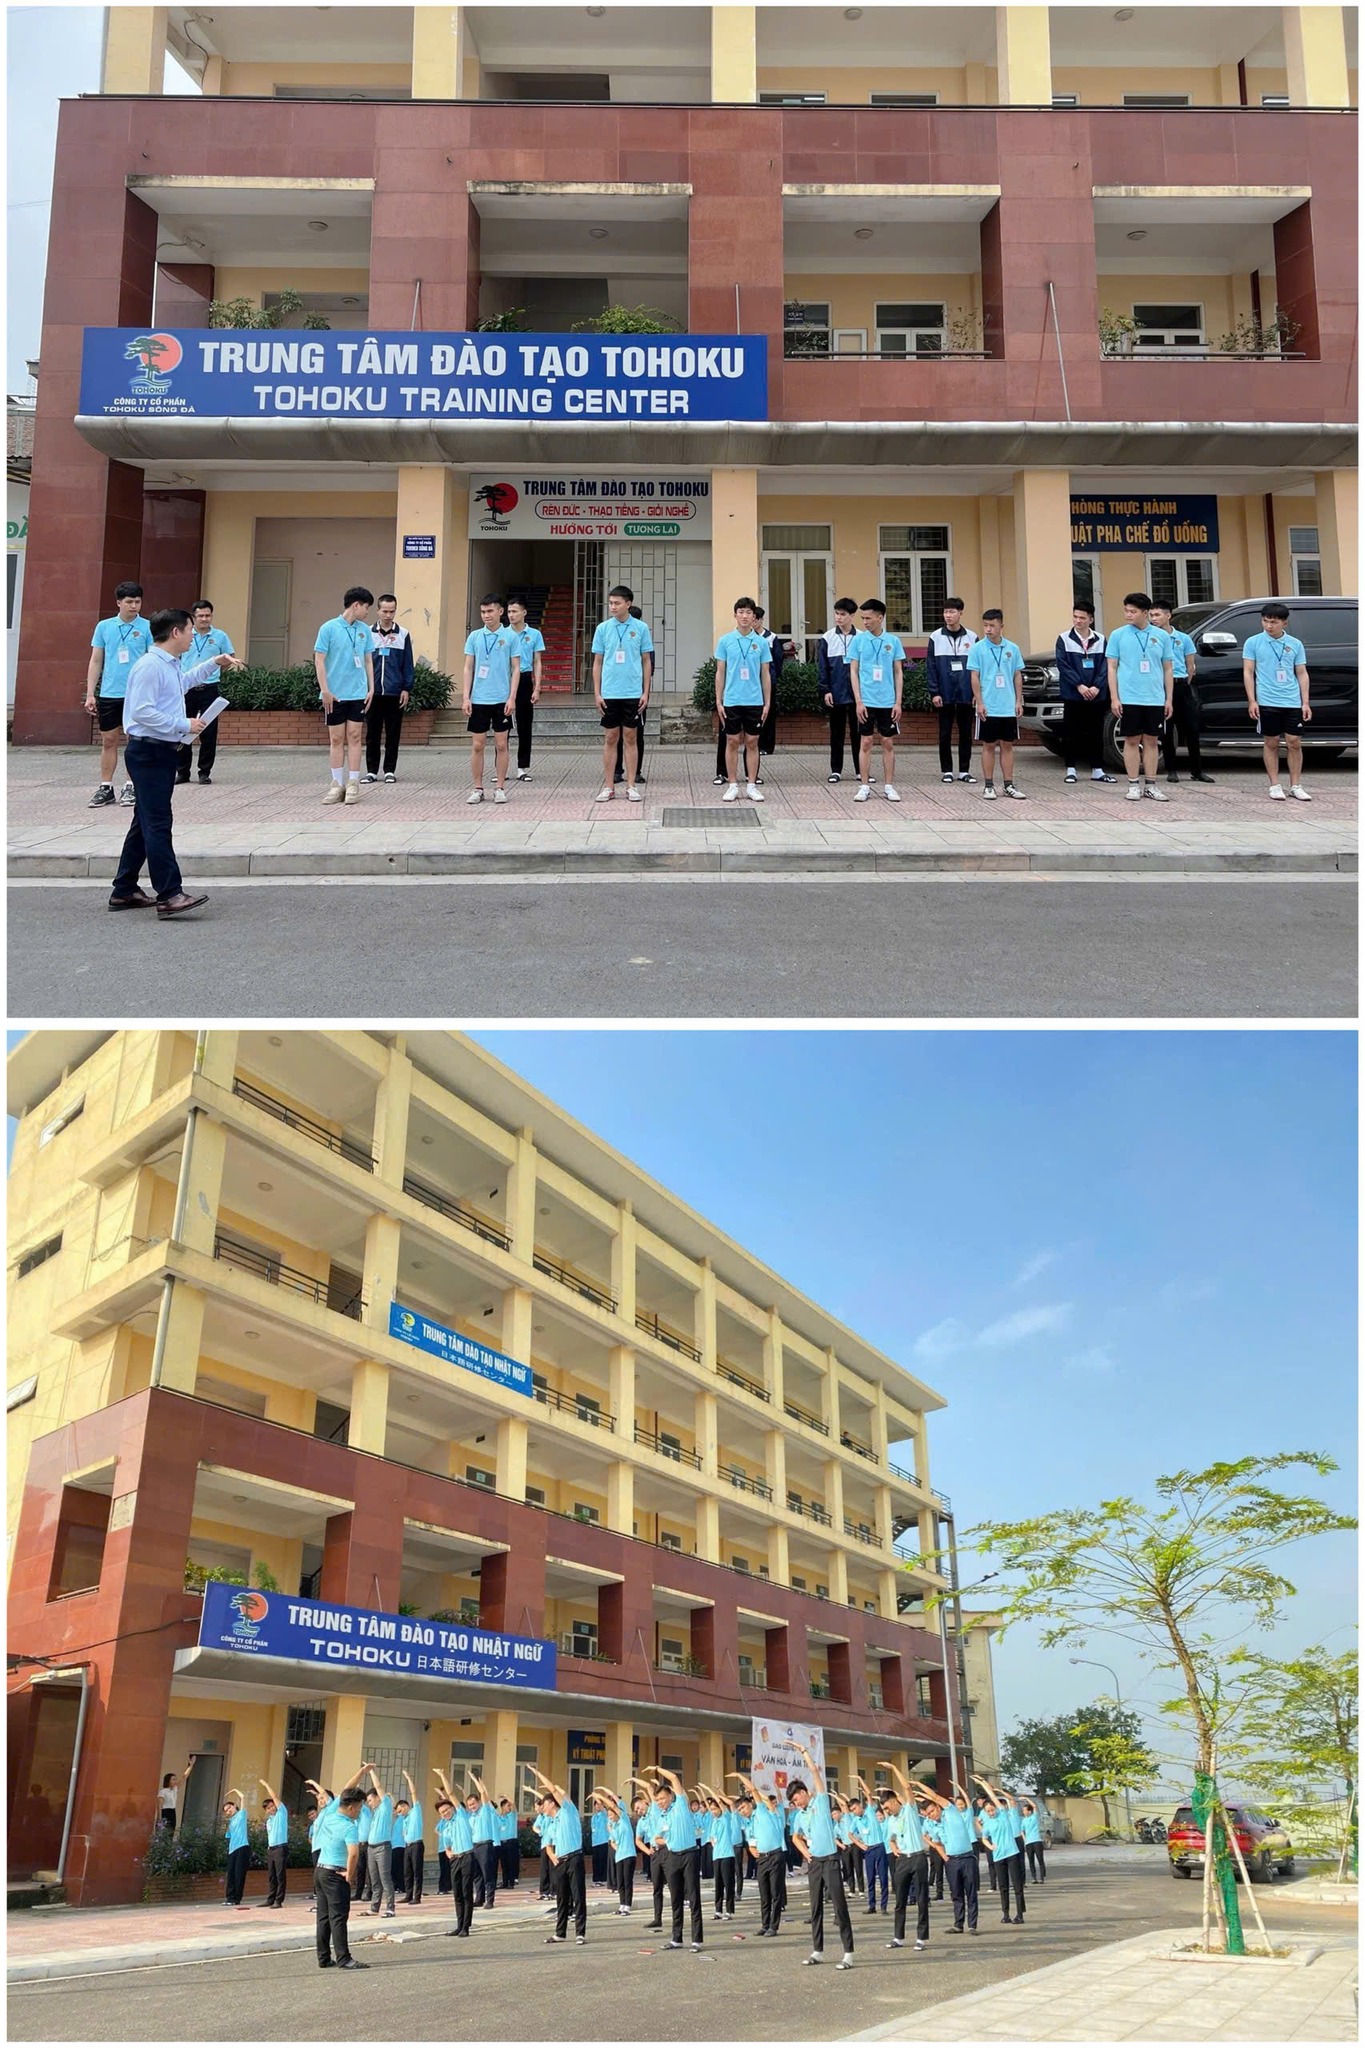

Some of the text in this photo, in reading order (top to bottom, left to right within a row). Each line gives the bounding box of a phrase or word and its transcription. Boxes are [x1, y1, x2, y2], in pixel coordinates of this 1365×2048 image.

[199, 337, 744, 383] TRUNG TÂM ĐÀO TẠO TOHOKU
[113, 397, 136, 406] CÔNG
[139, 398, 148, 406] TY
[148, 405, 177, 413] SÔNG
[180, 405, 196, 413] ĐÀ
[253, 385, 689, 414] TOHOKU TRAINING CENTER
[524, 478, 709, 499] TRUNG TÂM ĐÀO TẠO TOHOKU
[542, 503, 560, 516] RÈN
[562, 503, 581, 516] ĐỨC
[588, 505, 613, 518] THẠO
[615, 502, 640, 516] TIẾNG
[647, 503, 663, 516] GIỎI
[666, 502, 689, 516] NGHỀ
[1071, 498, 1177, 517] HÒNG THỰC HÀNH
[550, 523, 594, 535] HƯỚNG
[595, 523, 617, 535] TỚI
[662, 525, 677, 534] LAI
[1071, 519, 1208, 547] UẬT PHA CHẾ ĐỒ UỐNG
[422, 1323, 447, 1347] TRUNG
[448, 1334, 464, 1355] TÂM
[464, 1343, 479, 1361] ĐÀO
[480, 1350, 493, 1368] TẠO
[220, 1635, 236, 1643] CÔNG
[288, 1604, 543, 1662] TRUNG TÂM ĐÀO TẠO NHẬT NGỮ
[230, 1643, 258, 1651] TOHOKU
[310, 1638, 527, 1680] TOHOKU 日本語研修センター
